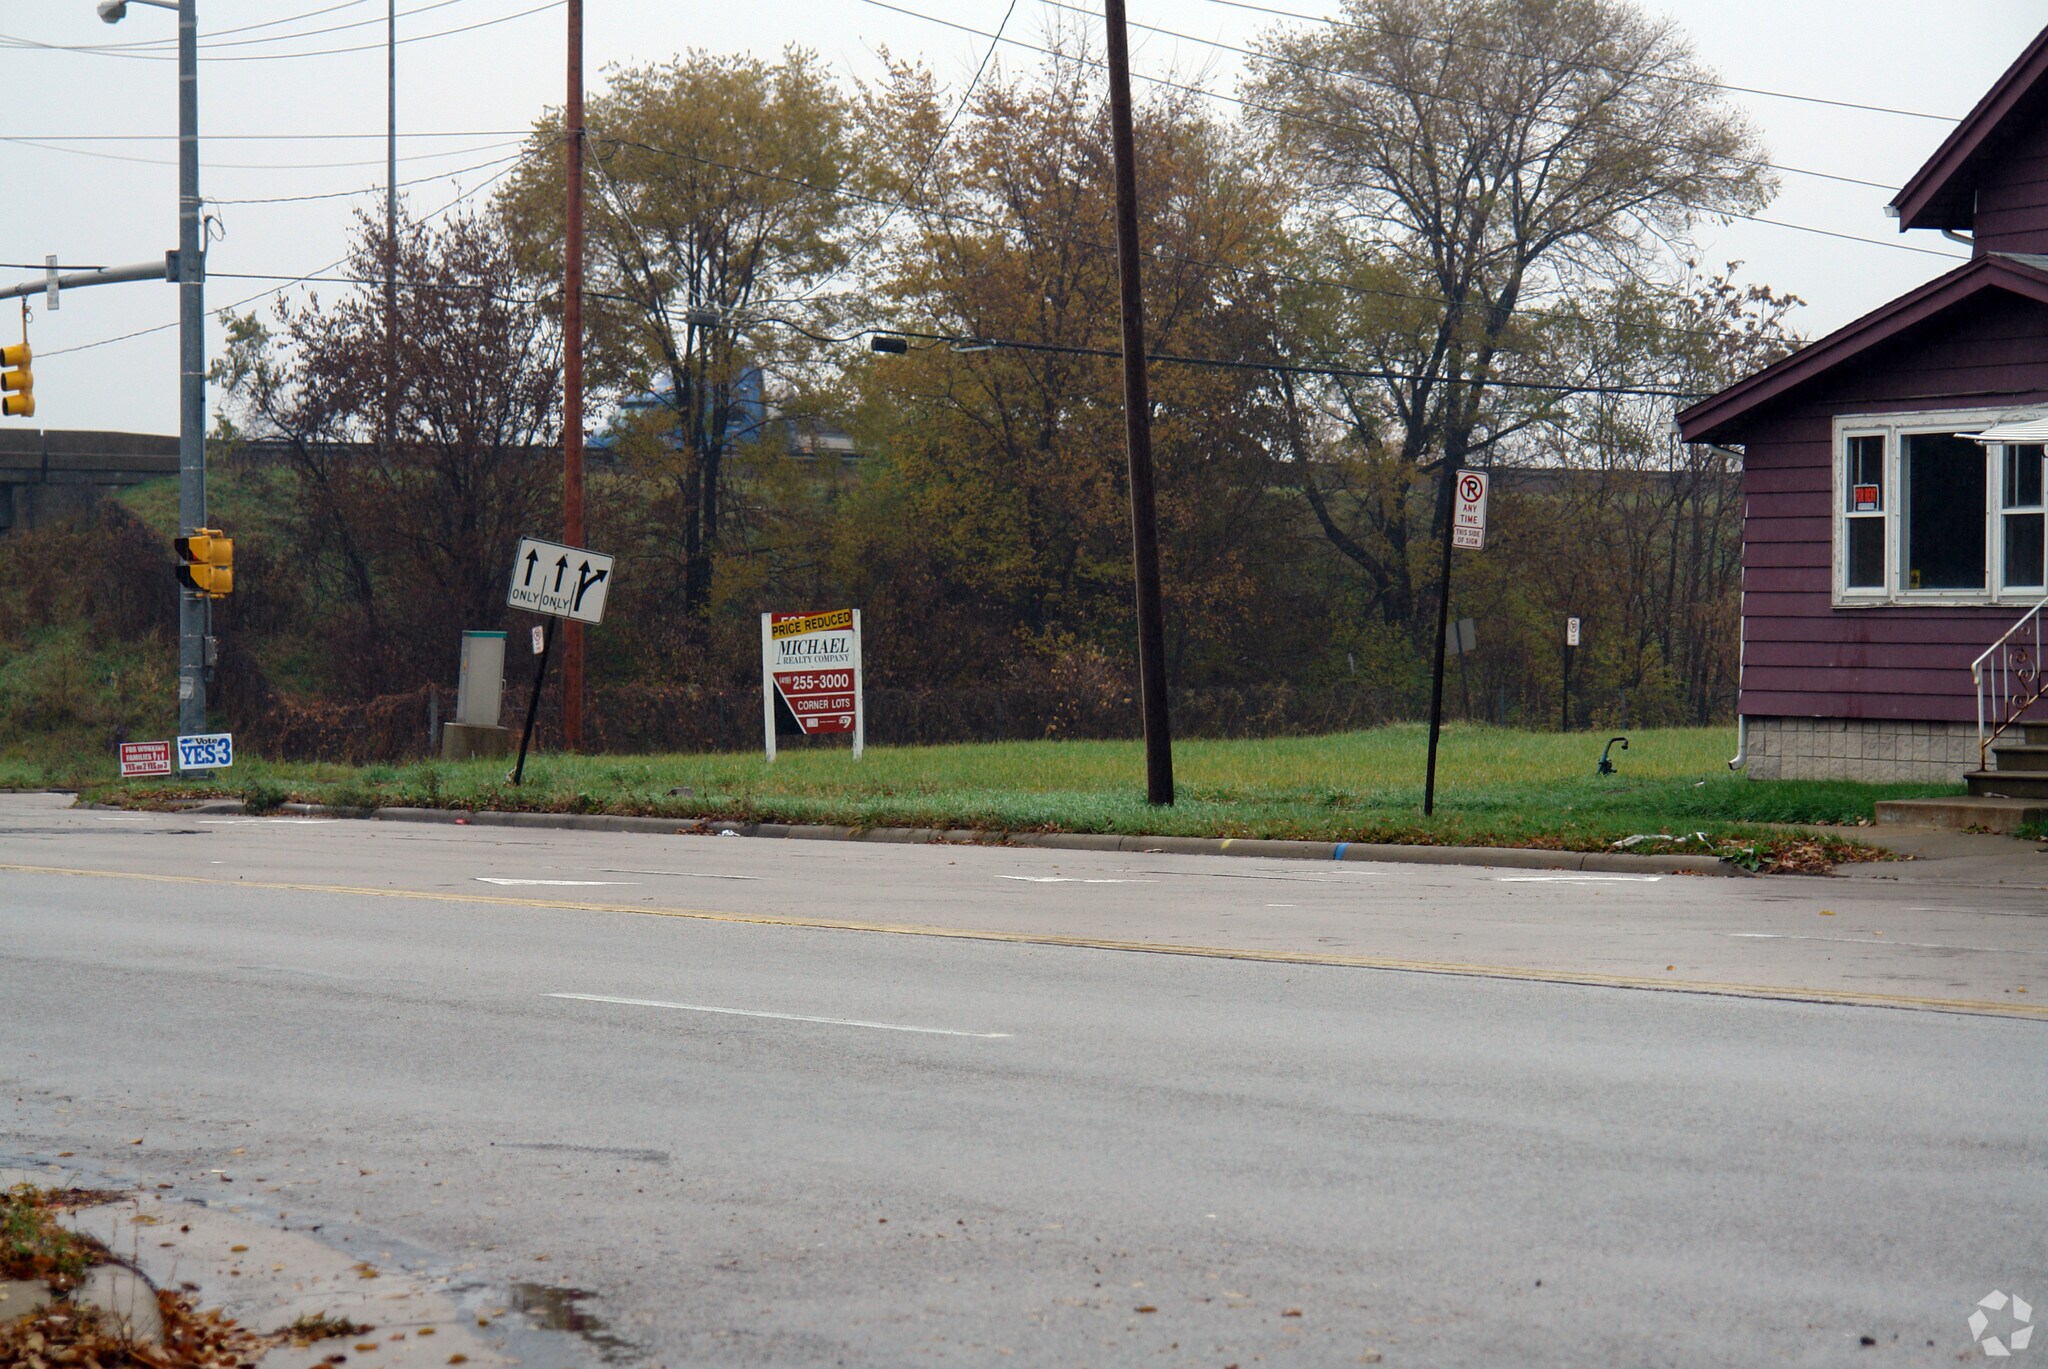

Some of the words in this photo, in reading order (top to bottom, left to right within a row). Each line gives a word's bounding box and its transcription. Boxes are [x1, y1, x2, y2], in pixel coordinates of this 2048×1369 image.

[1463, 504, 1477, 512] ANY
[1460, 514, 1478, 524] TIME
[512, 588, 540, 603] ONLY
[542, 595, 569, 609] ONLY
[772, 622, 801, 636] PRICE
[805, 612, 850, 630] REDUCED
[776, 638, 849, 664] MICHAEL
[784, 656, 812, 664] REALTY
[814, 654, 850, 663] COMPANY
[792, 674, 848, 690] 255-3000
[798, 700, 828, 710] CORNER
[832, 698, 850, 708] LOTS
[181, 744, 216, 765] YES
[218, 738, 230, 764] 3
